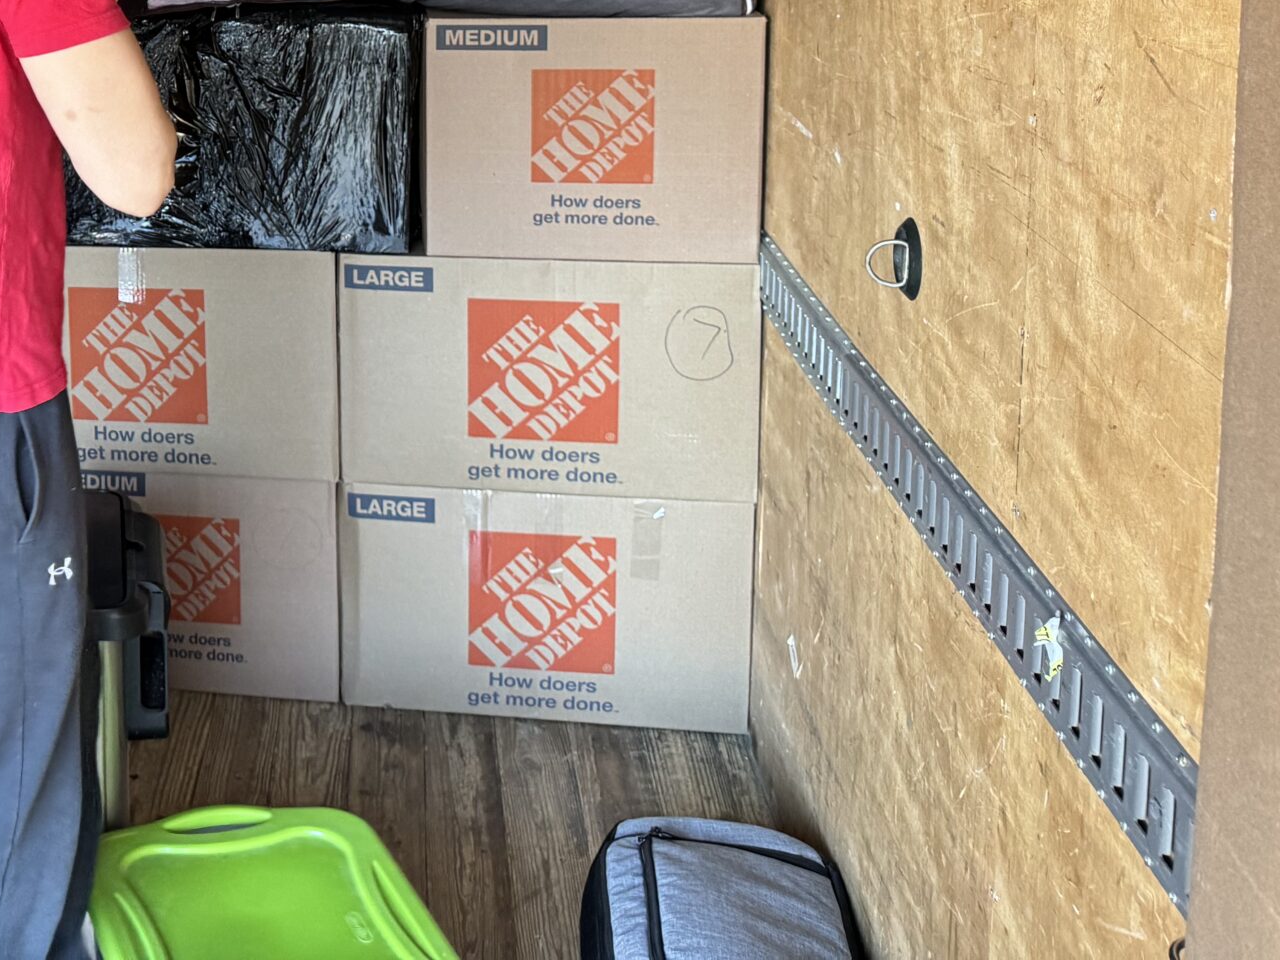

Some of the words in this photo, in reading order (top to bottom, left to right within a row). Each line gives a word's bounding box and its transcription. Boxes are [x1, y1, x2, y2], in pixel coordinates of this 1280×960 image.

[445, 29, 538, 46] MEDIUM
[531, 69, 655, 182] HOME
[543, 80, 595, 128] THE
[579, 112, 655, 182] DEPOT
[533, 211, 561, 226] get
[565, 213, 608, 225] more
[551, 194, 588, 208] How
[593, 195, 641, 209] doers
[353, 269, 424, 287] LARGE
[82, 302, 139, 356] THE
[482, 314, 545, 371] THE
[72, 289, 205, 420] HOME
[468, 302, 620, 439] HOME
[125, 339, 206, 421] DEPOT
[526, 355, 619, 440] DEPOT
[77, 445, 106, 462] get
[111, 448, 158, 462] more
[94, 425, 135, 442] How
[141, 428, 195, 445] doers
[490, 443, 534, 460] How
[541, 446, 600, 463] doers
[81, 473, 138, 492] DIUM
[468, 464, 500, 480] get
[507, 467, 559, 480] more
[356, 498, 426, 518] LARGE
[167, 517, 241, 600] OME
[482, 547, 545, 602] THE
[176, 558, 240, 622] DEPOT
[469, 536, 616, 667] HOME
[188, 633, 232, 647] doers
[525, 589, 616, 671] DEPOT
[468, 691, 500, 706] get
[506, 694, 556, 708] more
[489, 672, 533, 689] How
[539, 676, 597, 693] doers
